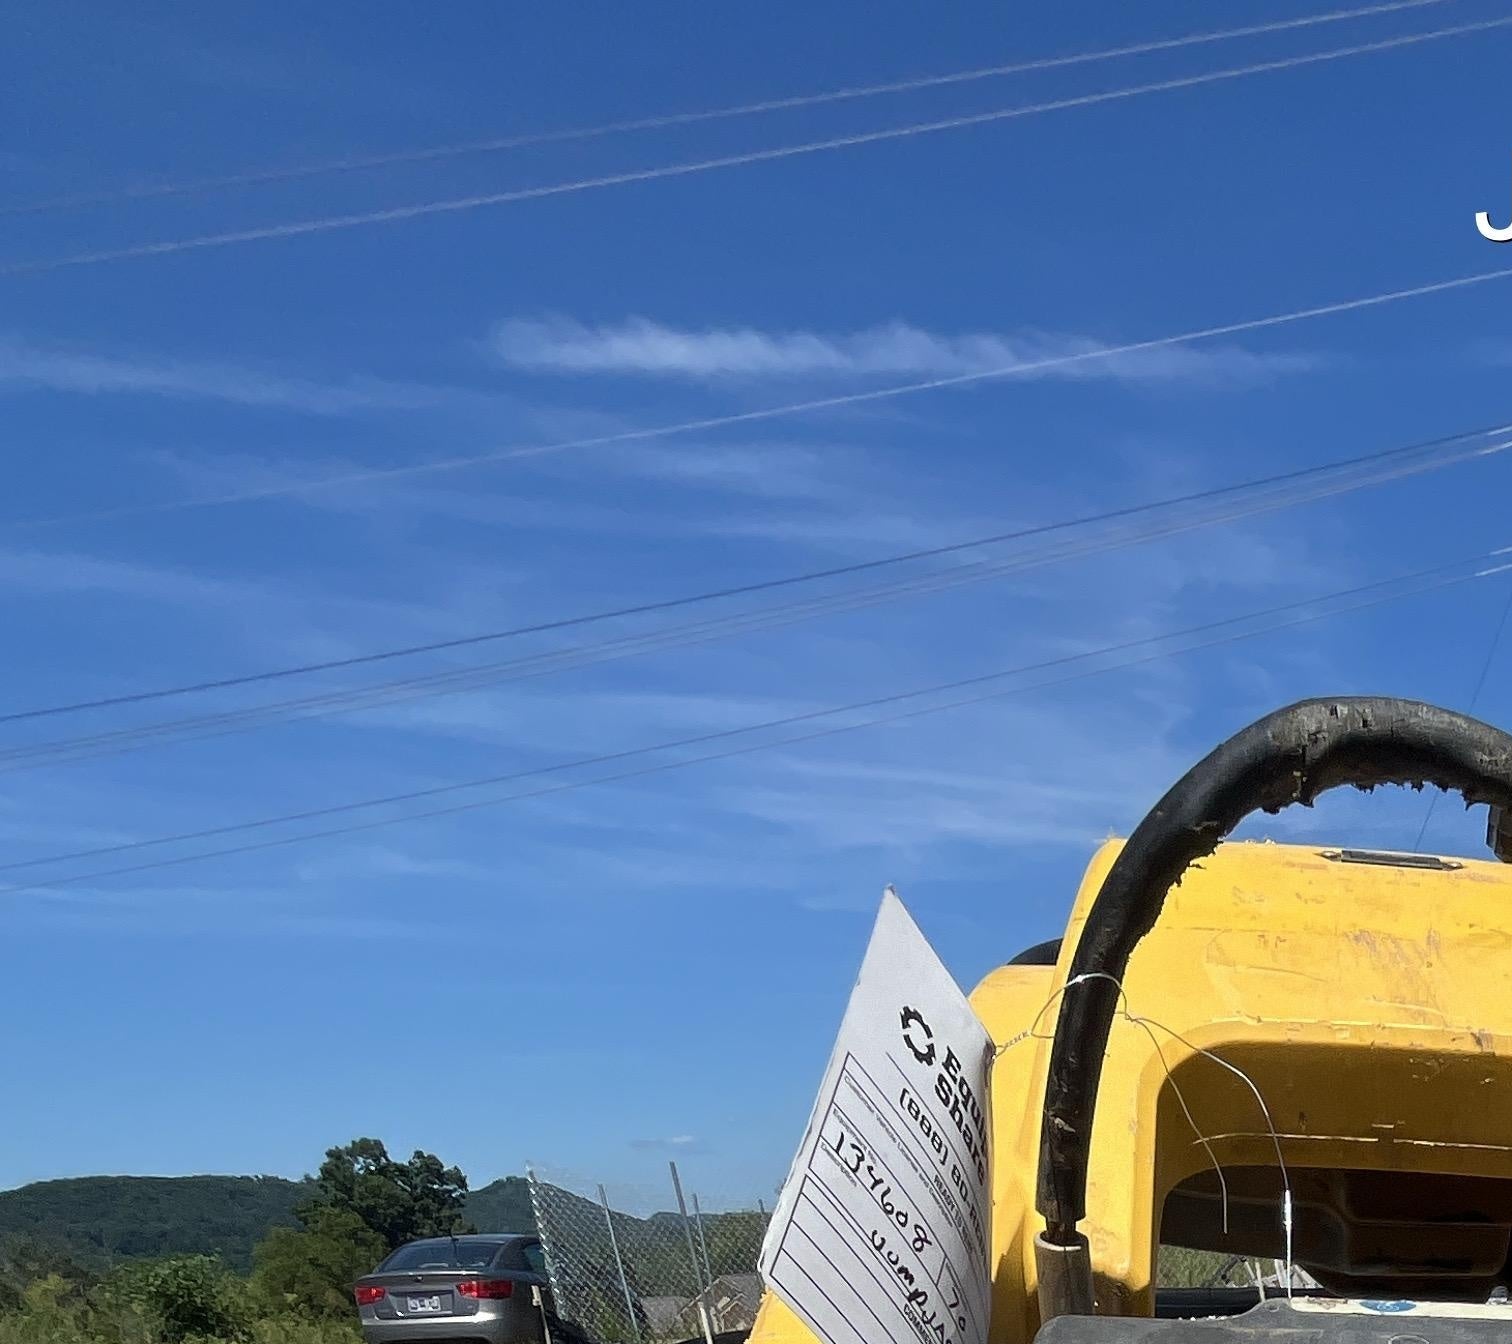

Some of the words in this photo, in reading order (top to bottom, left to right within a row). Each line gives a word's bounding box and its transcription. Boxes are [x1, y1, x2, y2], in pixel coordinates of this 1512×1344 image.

[899, 1087, 949, 1166] (888)
[934, 1072, 985, 1187] Share
[835, 1131, 933, 1253] 134608
